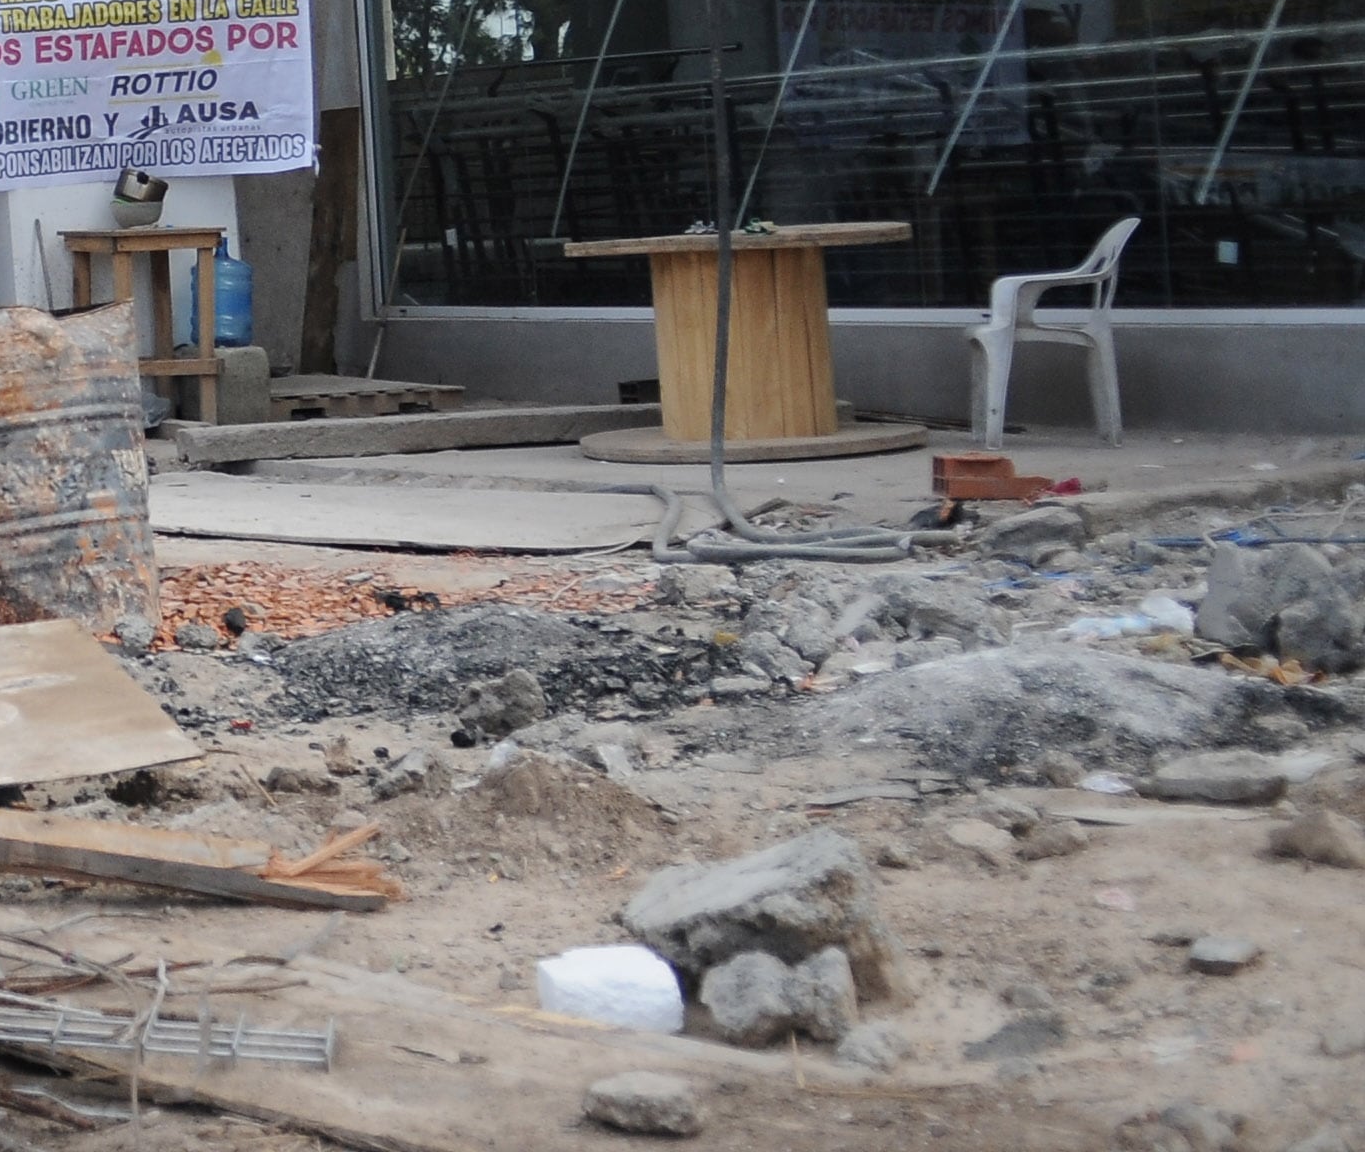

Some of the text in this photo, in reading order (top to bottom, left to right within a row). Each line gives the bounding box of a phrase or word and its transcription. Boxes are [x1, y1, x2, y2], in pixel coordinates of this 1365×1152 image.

[35, 25, 214, 63] ESTAFADOS
[227, 22, 299, 51] POR
[11, 76, 89, 101] GREEN
[110, 69, 218, 97] ROTTIO
[103, 112, 119, 137] Y
[177, 101, 260, 124] AUSA
[164, 123, 261, 135] autopistas urbanas
[122, 140, 157, 168] POR
[160, 136, 195, 164] LOS
[199, 134, 306, 163] AFECTADOS
